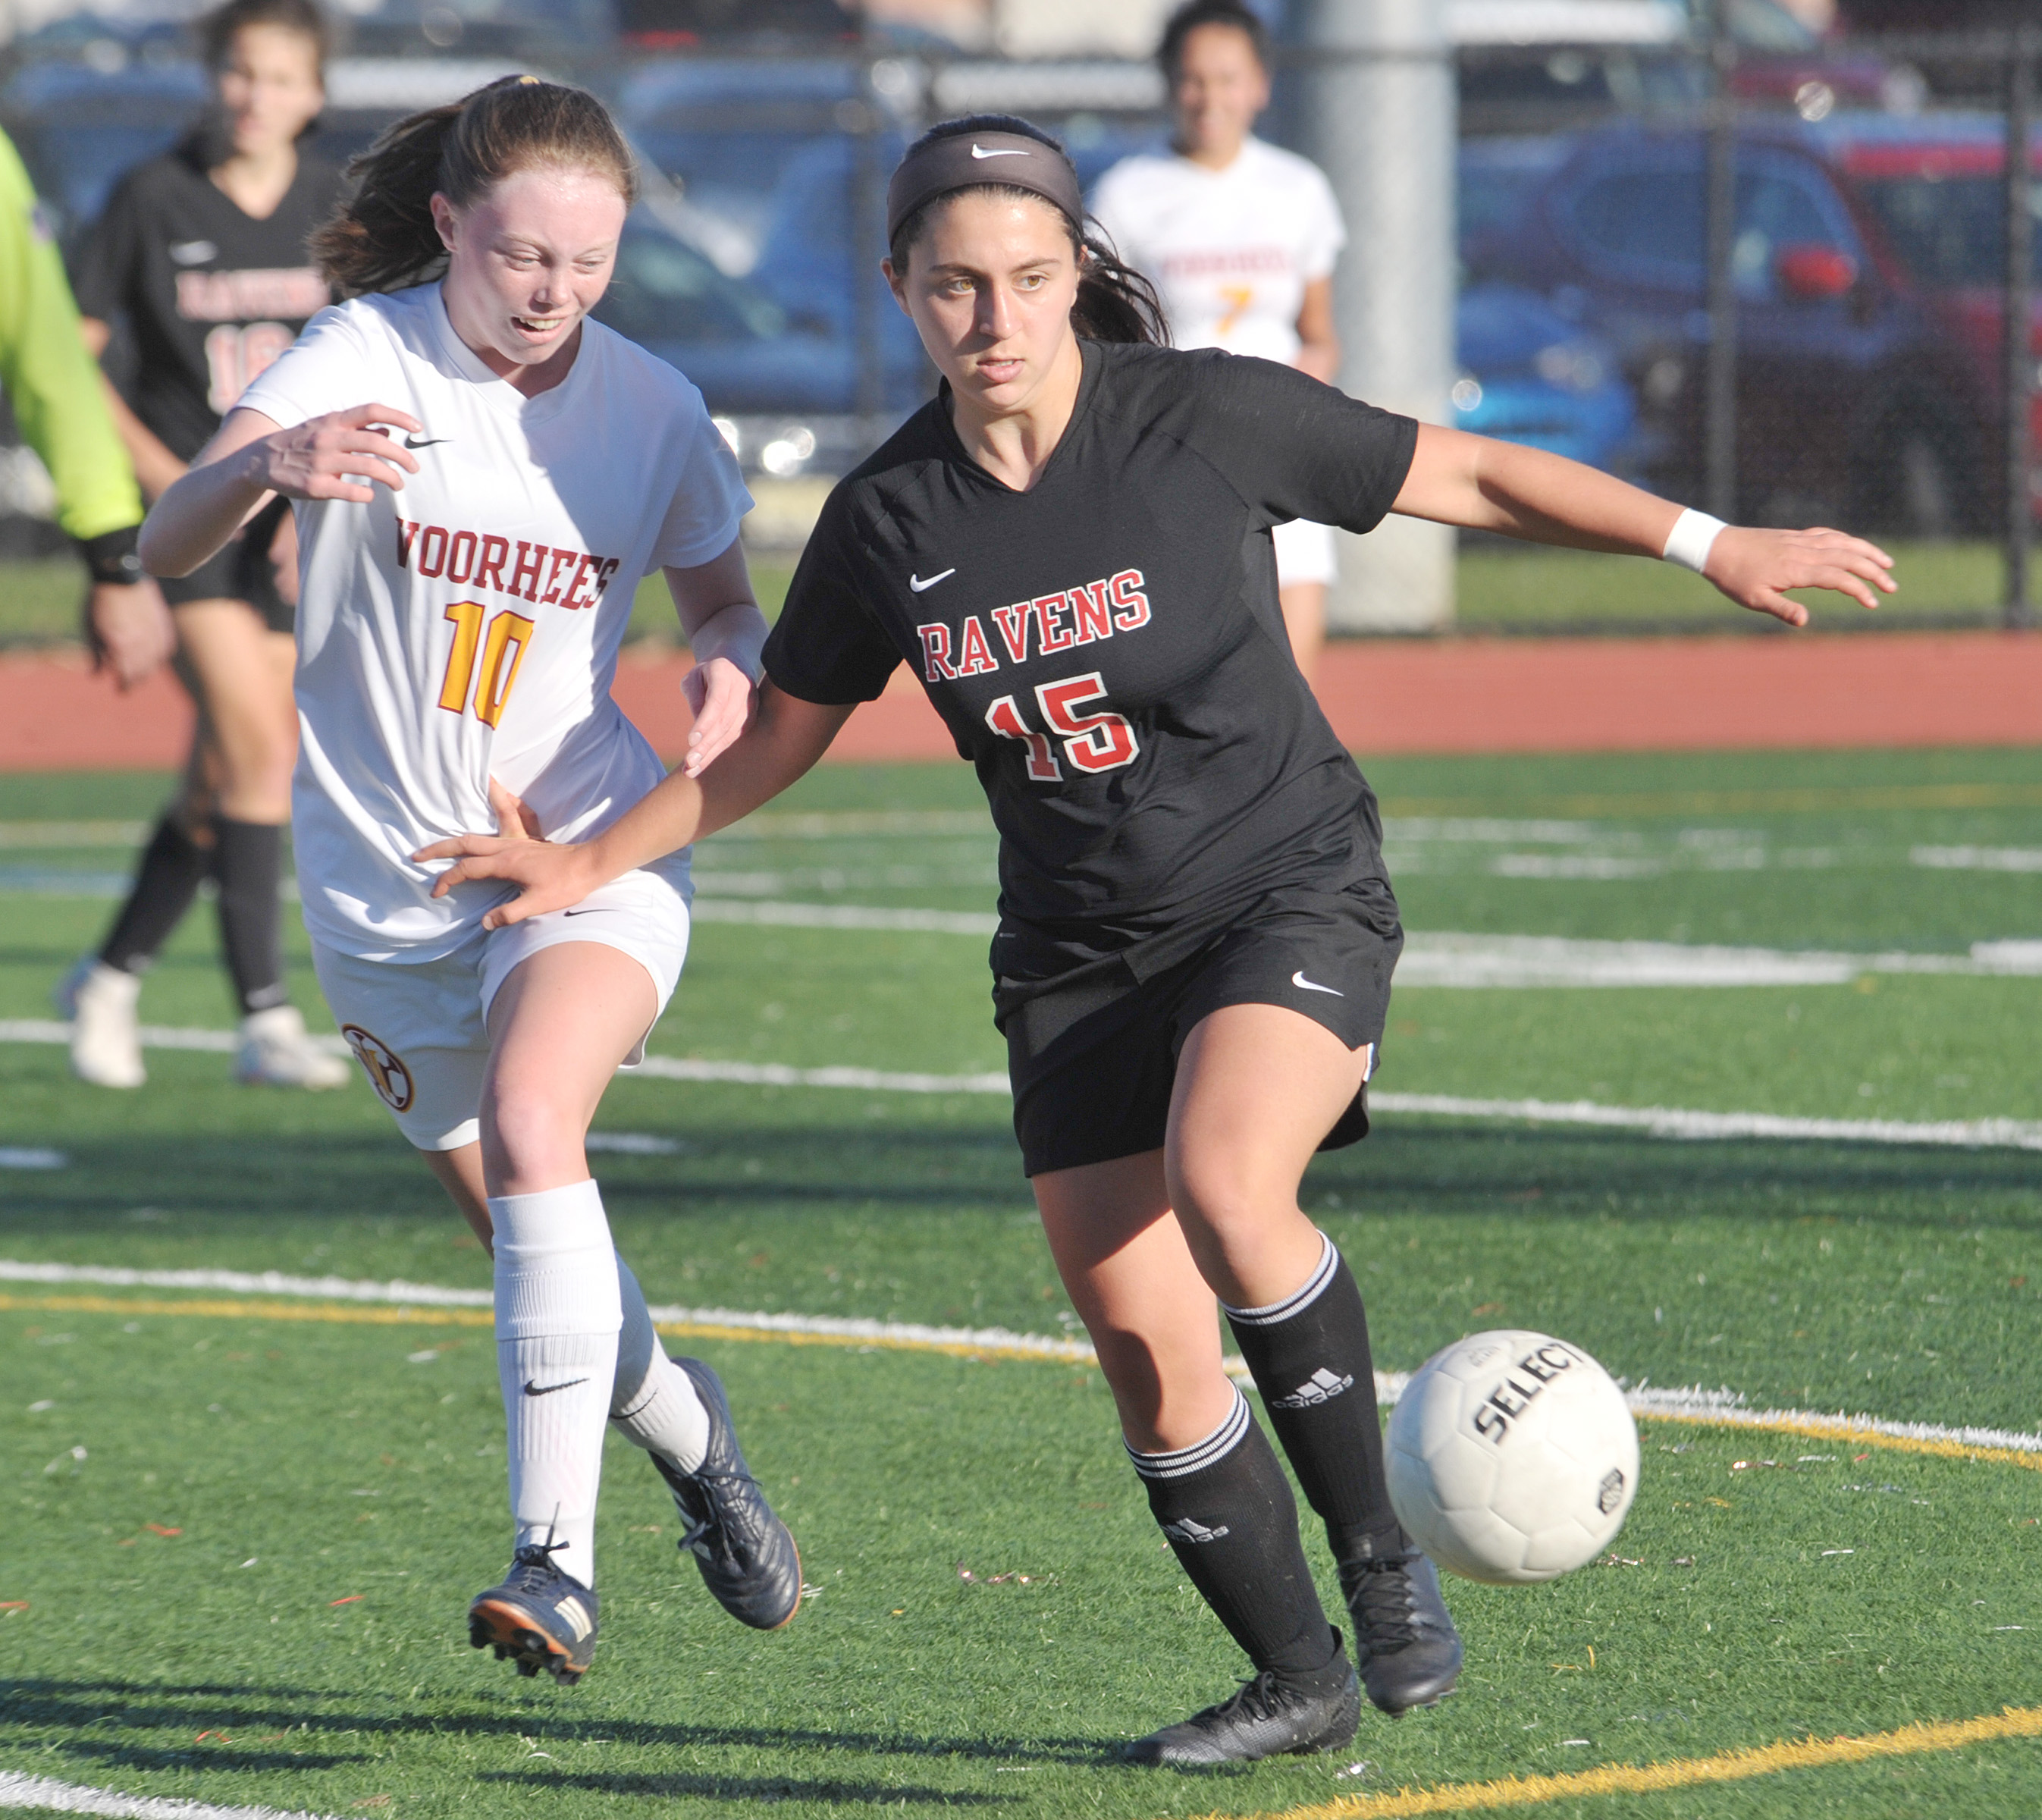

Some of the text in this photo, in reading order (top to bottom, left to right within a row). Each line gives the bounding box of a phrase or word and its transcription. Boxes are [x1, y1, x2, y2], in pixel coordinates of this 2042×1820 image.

[1216, 284, 1254, 337] 7
[395, 516, 620, 610] VOORHEES
[437, 600, 535, 731] 10
[917, 568, 1151, 682] RAVENS
[984, 671, 1140, 782] 15
[1272, 1374, 1353, 1408] adidas
